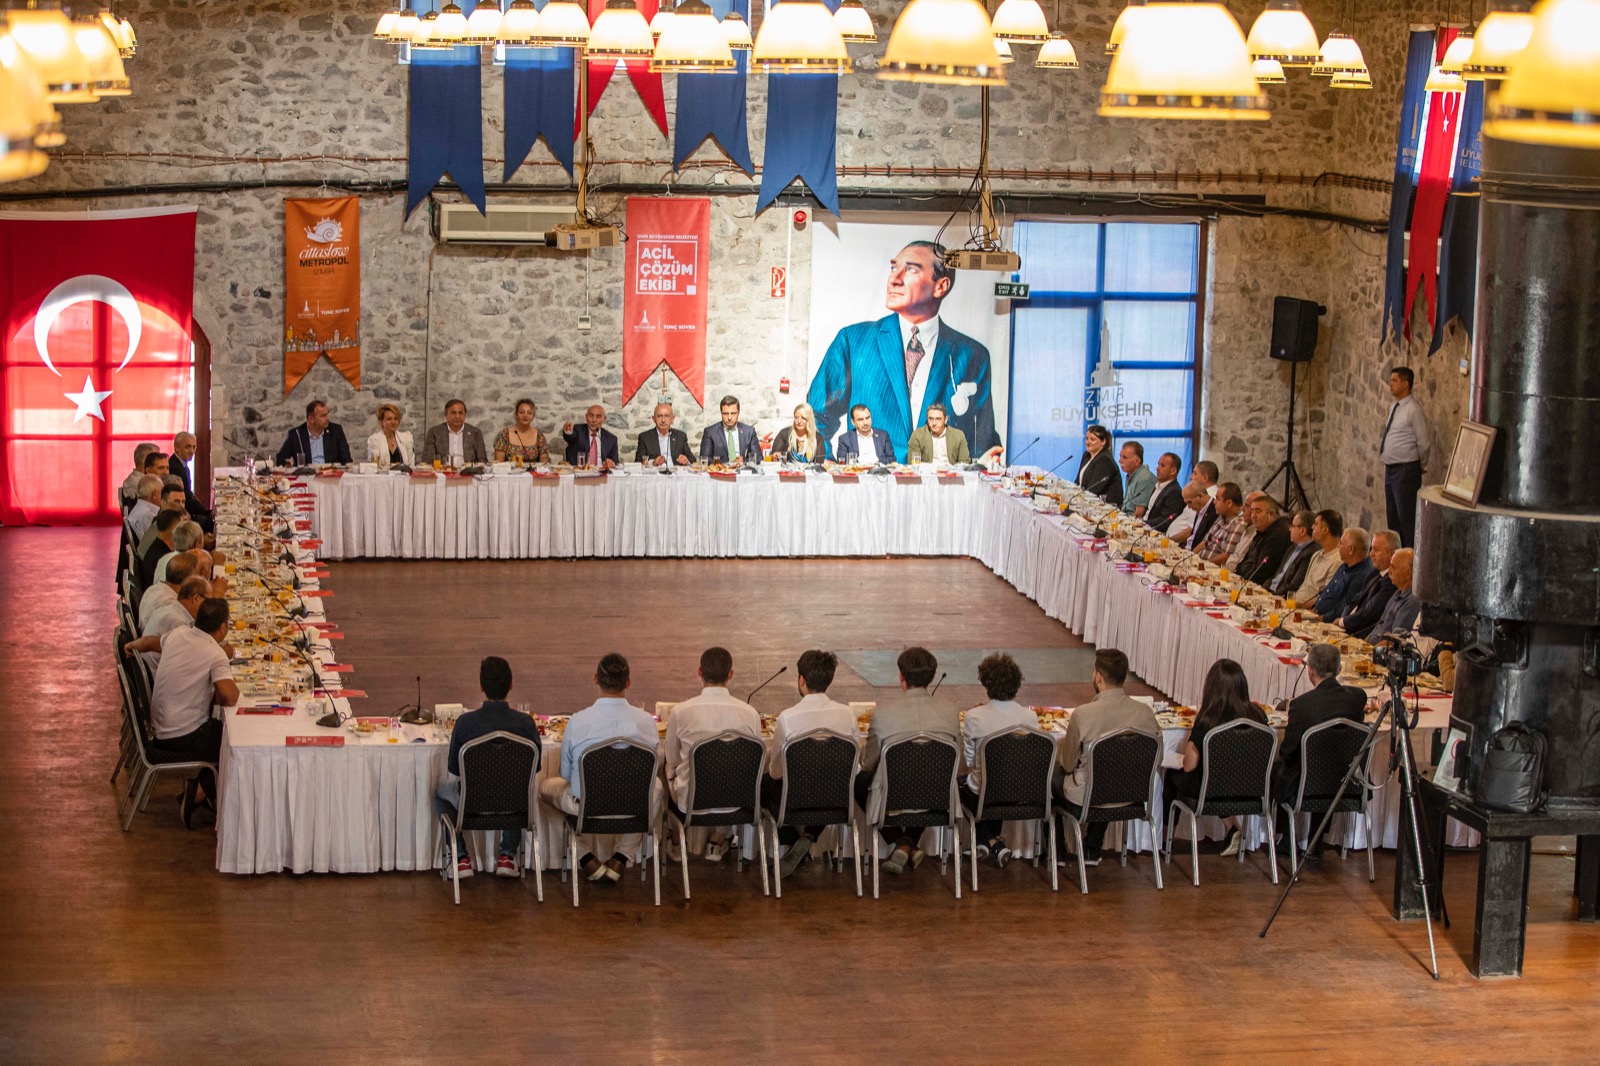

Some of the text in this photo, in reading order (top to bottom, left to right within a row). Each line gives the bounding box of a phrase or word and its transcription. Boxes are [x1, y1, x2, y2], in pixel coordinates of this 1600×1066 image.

[299, 243, 349, 259] cittaslow
[641, 244, 675, 260] ACİL
[300, 257, 349, 267] METROPOL
[640, 260, 693, 278] ÇÖZÜM
[640, 275, 677, 291] EKİBİ
